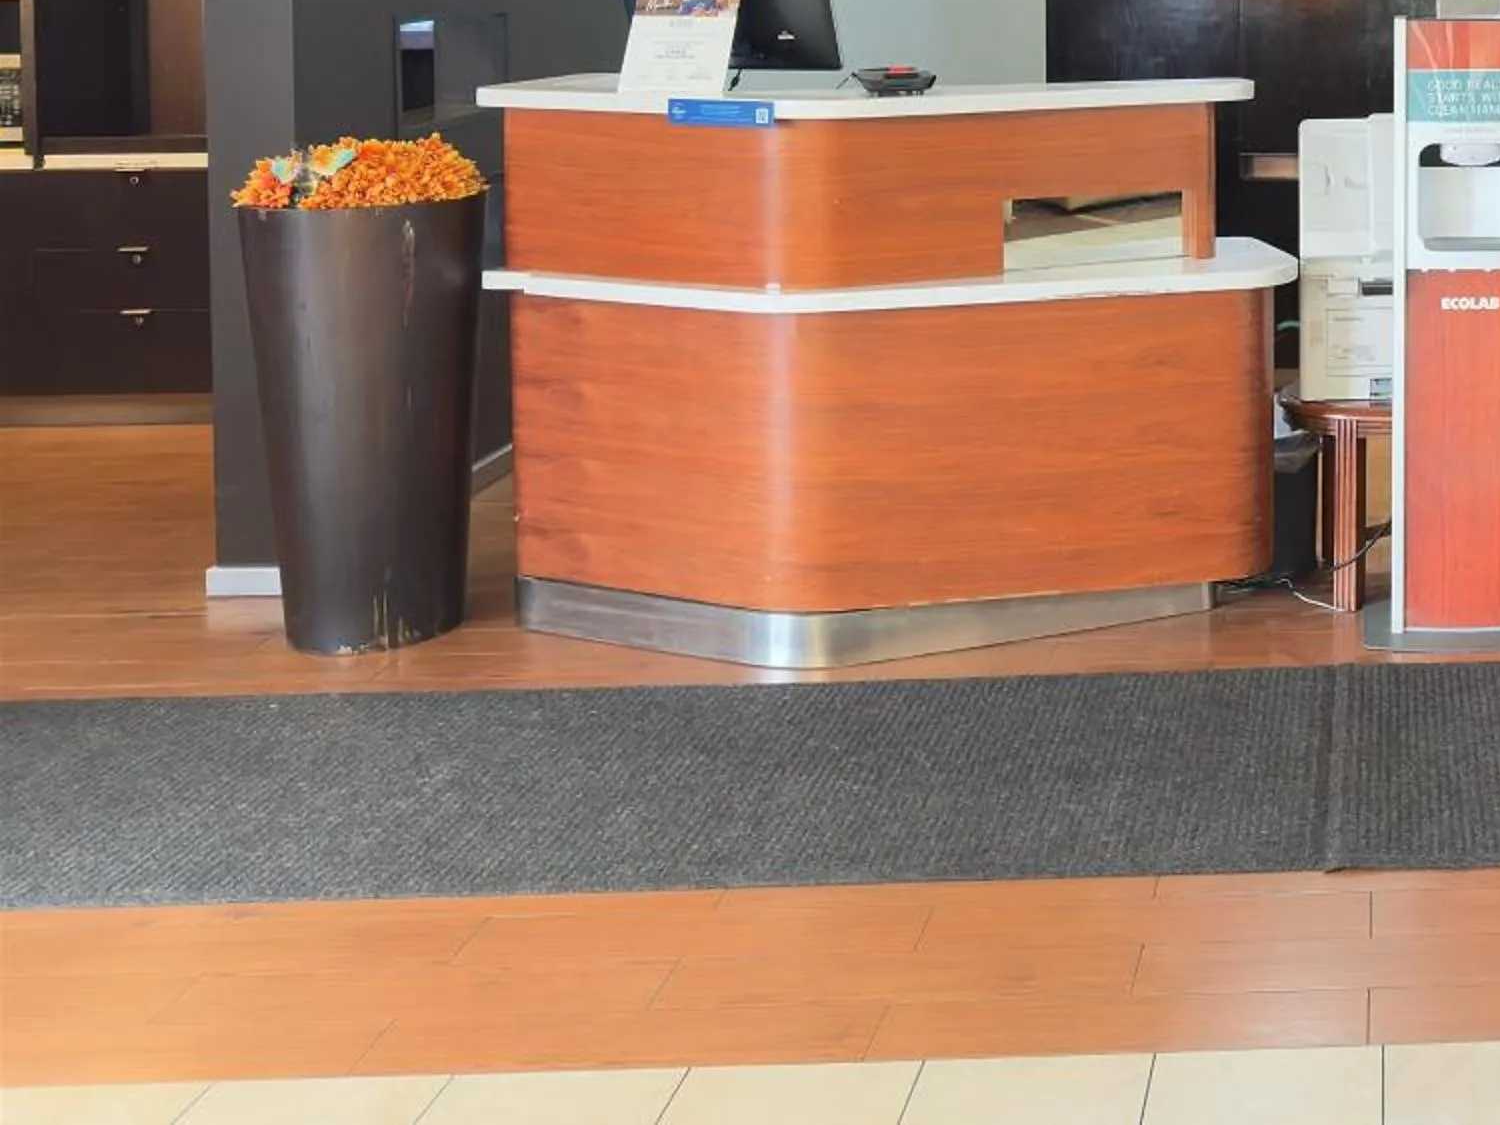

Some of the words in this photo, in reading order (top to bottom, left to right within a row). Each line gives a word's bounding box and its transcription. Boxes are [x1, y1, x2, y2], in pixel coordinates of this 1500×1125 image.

[1427, 78, 1463, 91] GOOD
[1427, 91, 1475, 104] STARTS
[1427, 104, 1469, 116] CLEAN
[1440, 296, 1500, 311] ECOLAB
